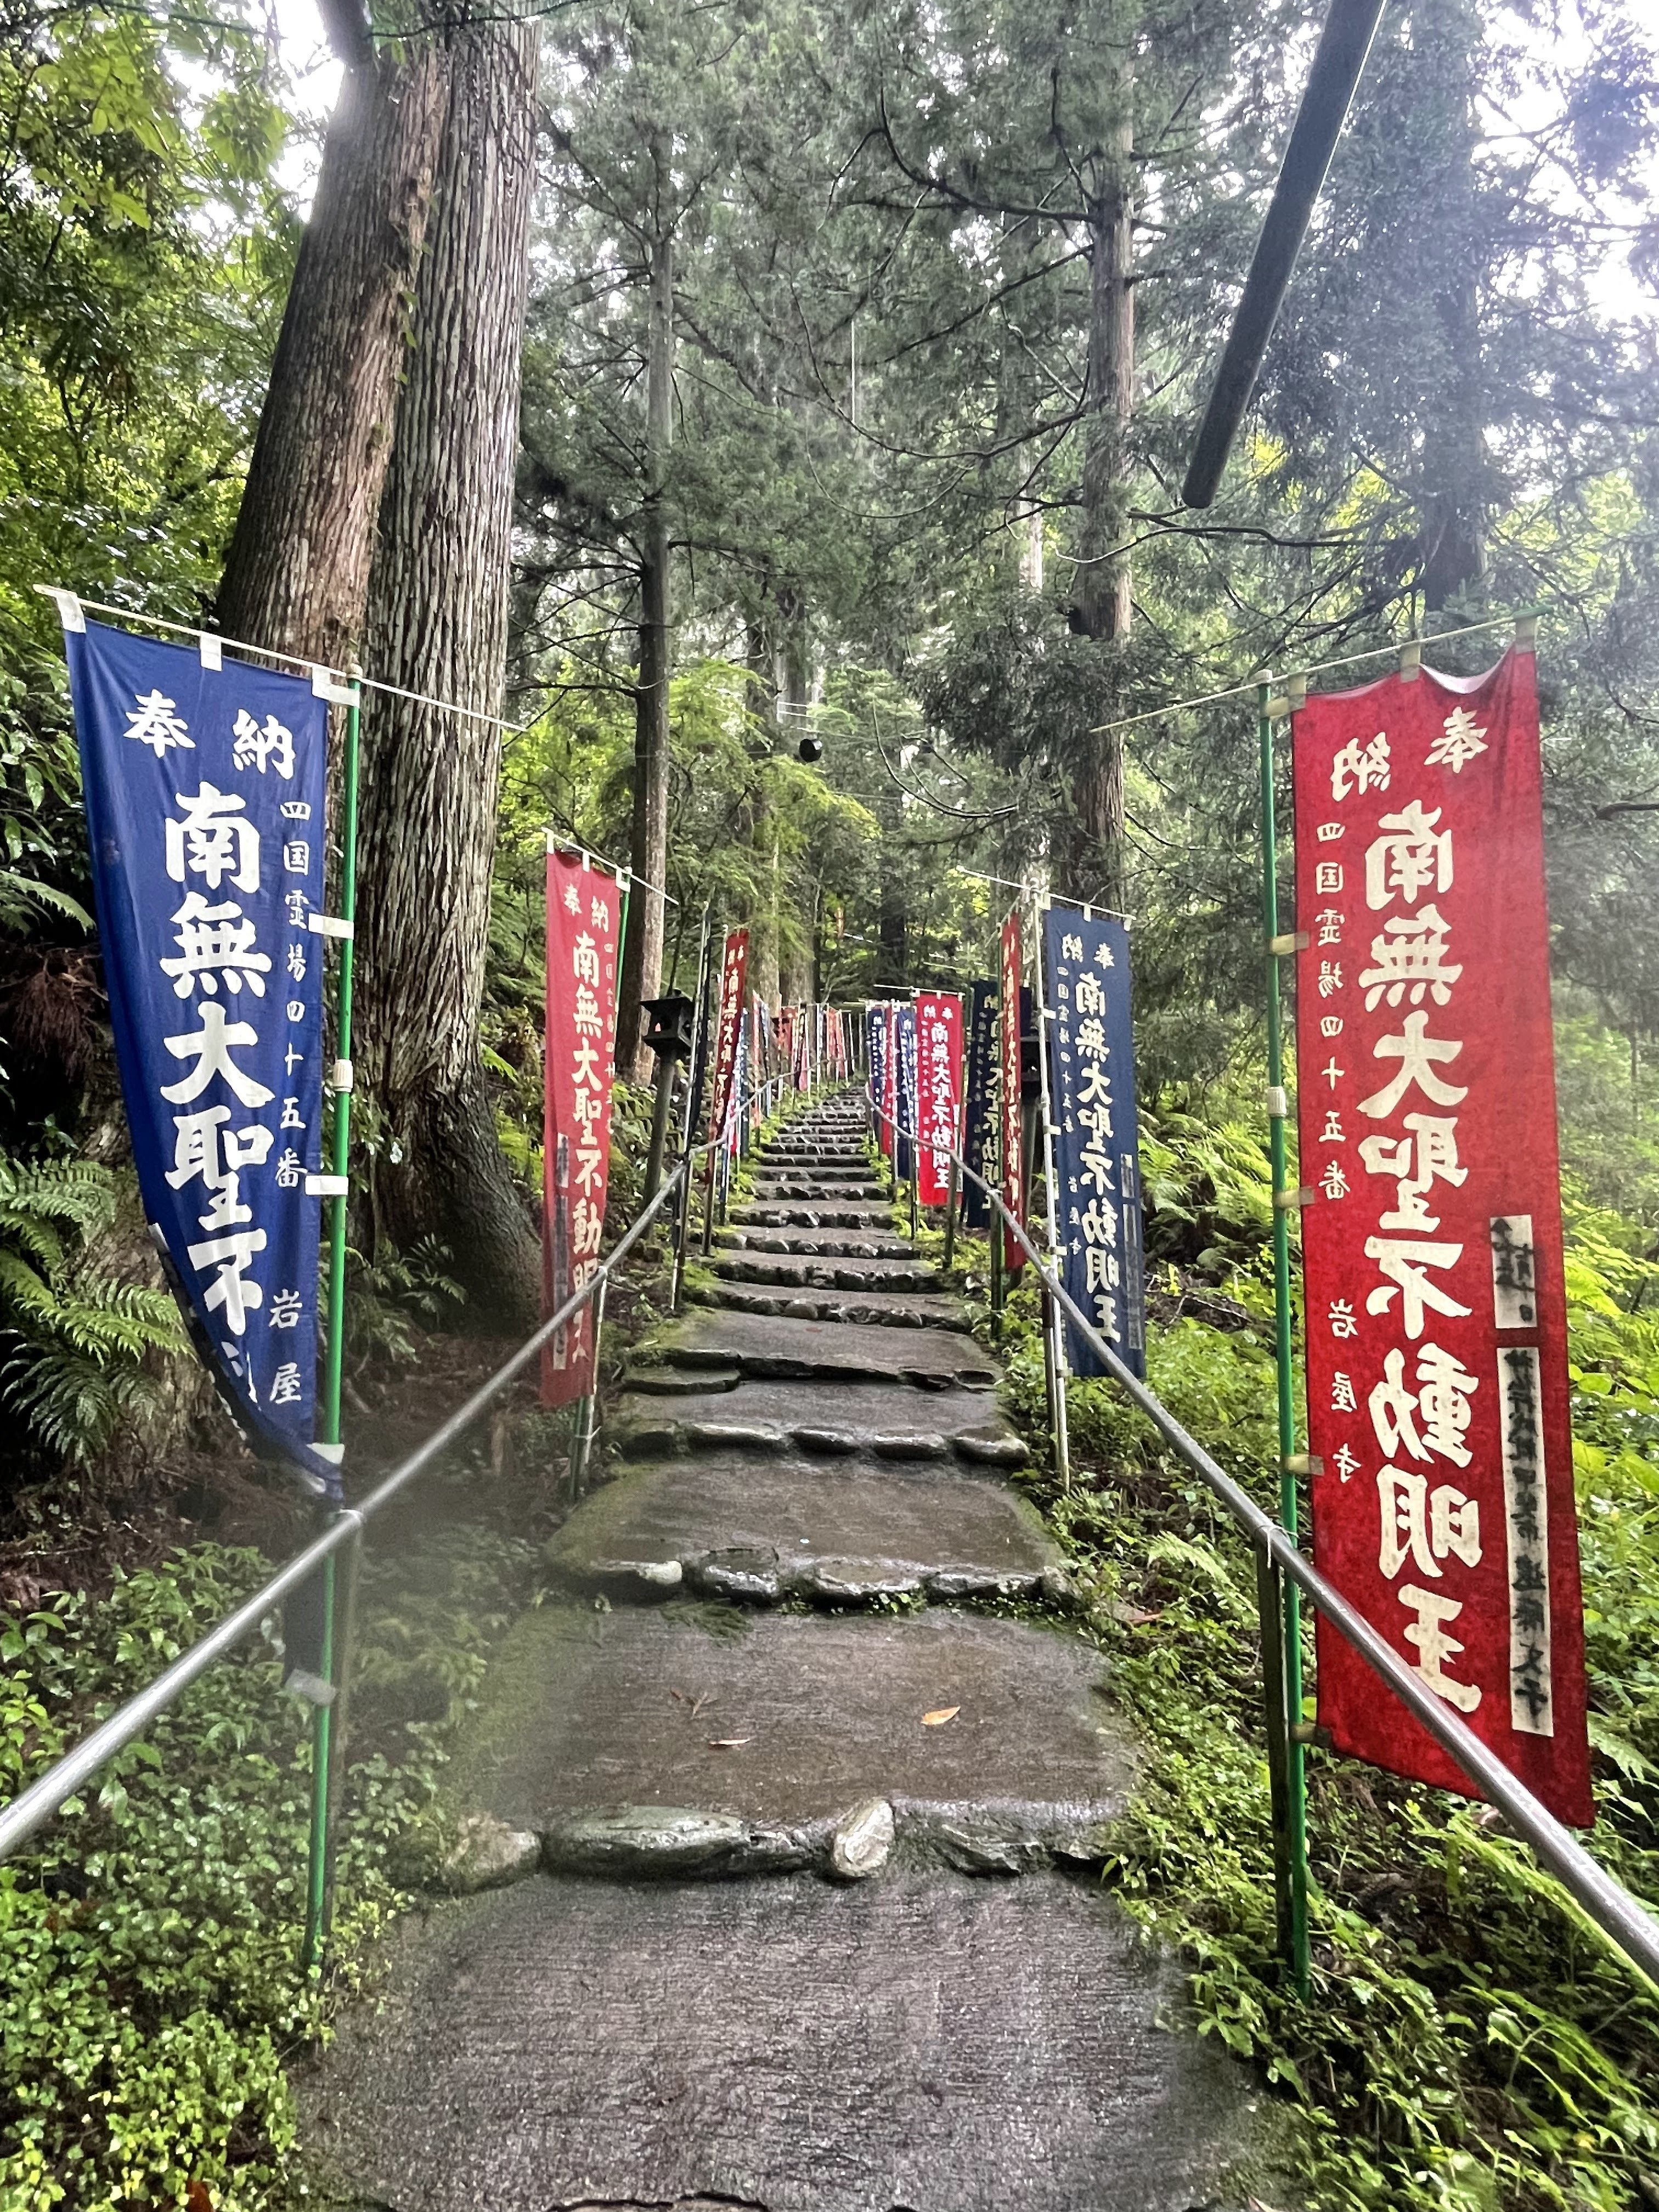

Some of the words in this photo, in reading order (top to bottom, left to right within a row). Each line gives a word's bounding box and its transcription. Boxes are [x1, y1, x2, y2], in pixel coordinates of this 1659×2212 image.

[123, 689, 296, 780] 奉納
[275, 802, 311, 1188] 四国霊場四十五番
[564, 883, 609, 933] 奉納
[160, 782, 276, 1404] 南無大聖不
